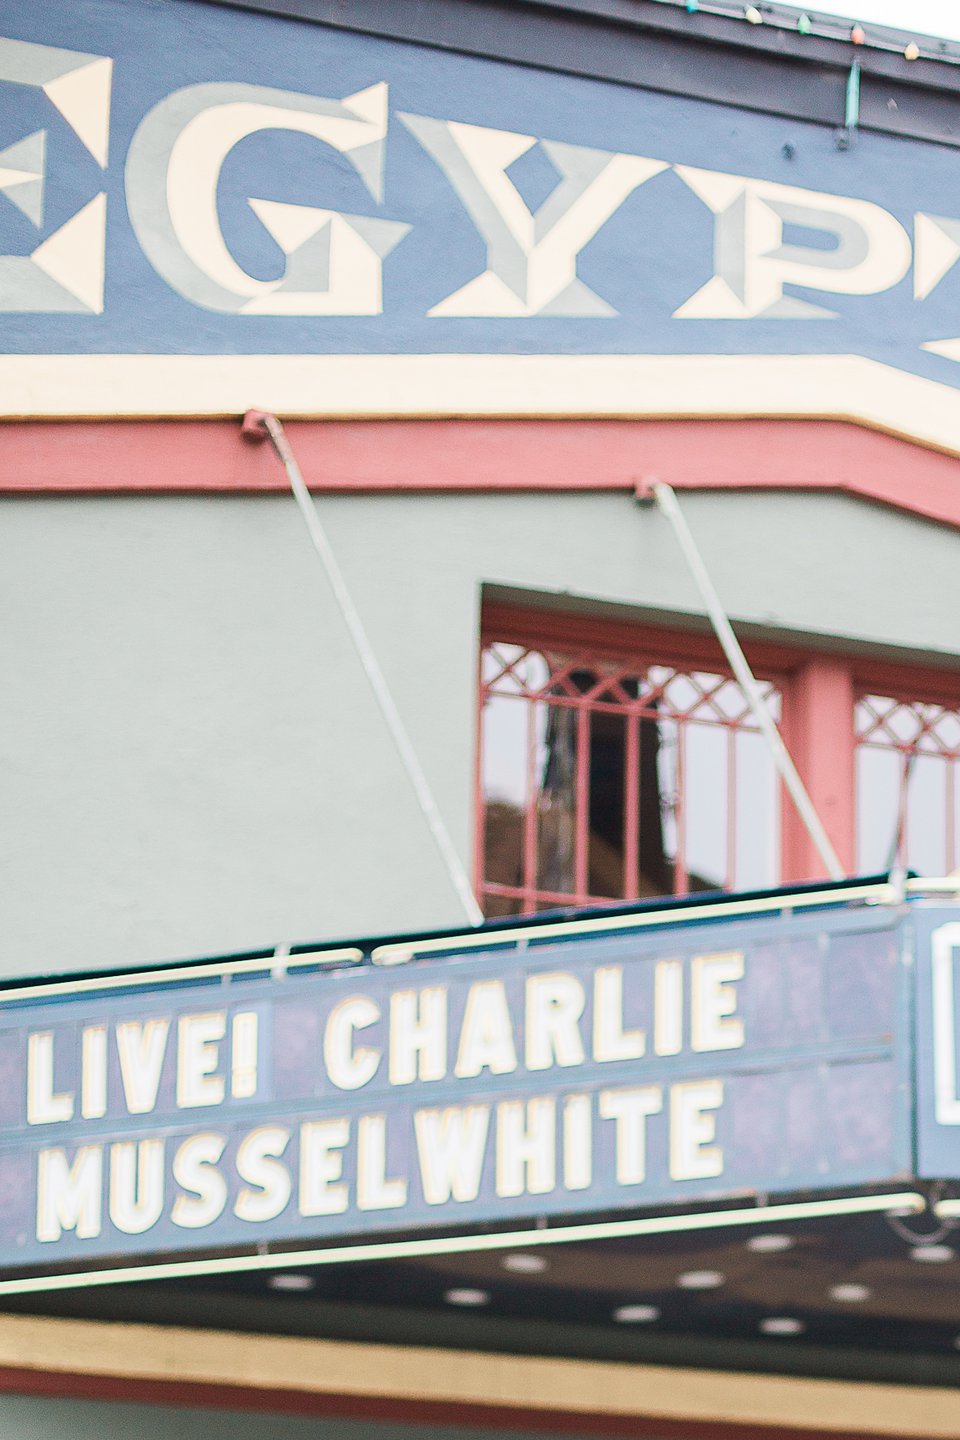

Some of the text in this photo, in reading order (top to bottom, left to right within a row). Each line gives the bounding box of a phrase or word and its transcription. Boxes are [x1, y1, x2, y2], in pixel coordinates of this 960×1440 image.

[27, 952, 746, 1125] LIVE! CHARLIE
[36, 1078, 726, 1243] MUSSELWHITE
